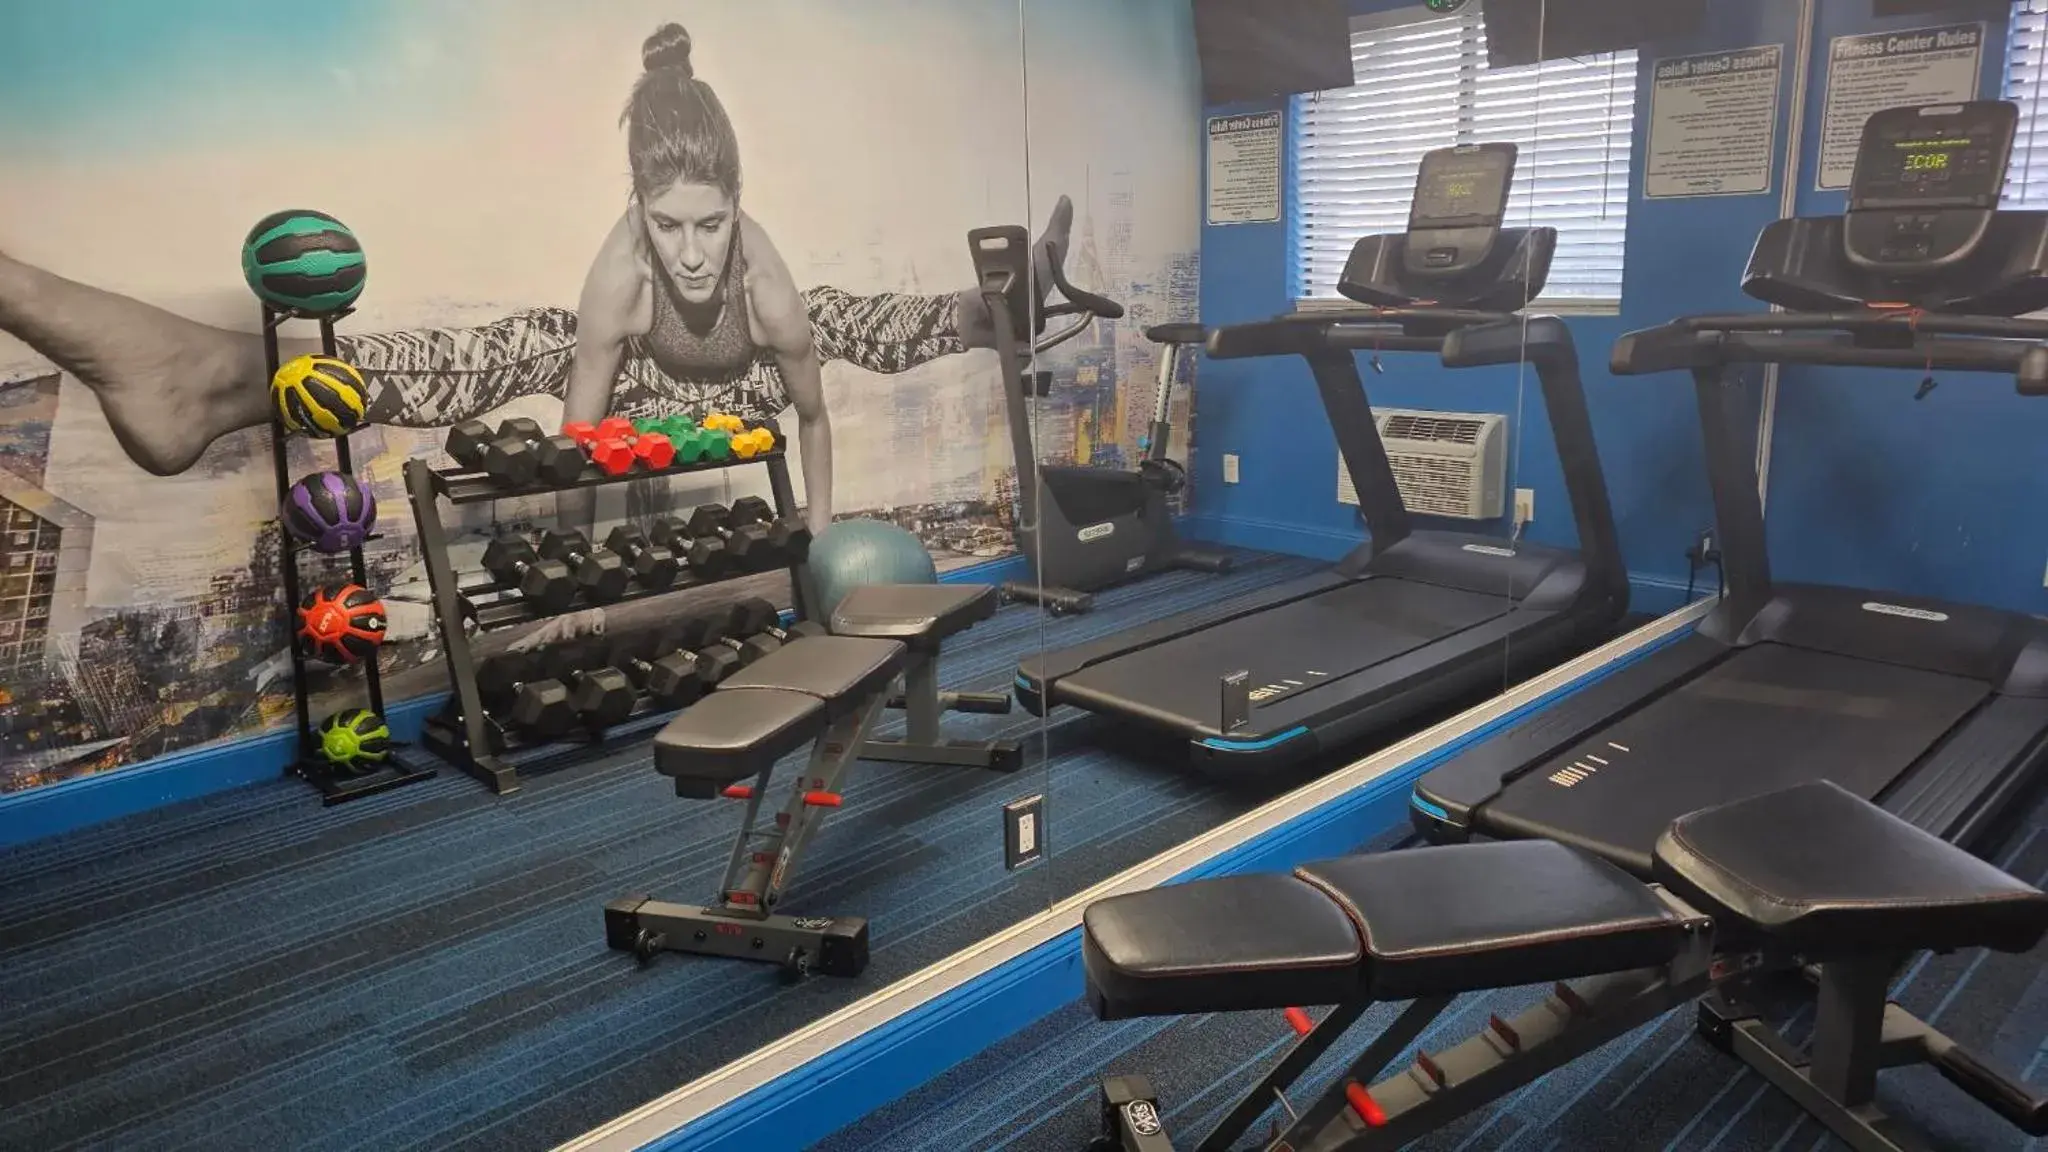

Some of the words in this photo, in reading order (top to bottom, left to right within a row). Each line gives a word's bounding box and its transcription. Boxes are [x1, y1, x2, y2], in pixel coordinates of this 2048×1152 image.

[1836, 41, 1884, 58] Fitness
[1887, 35, 1934, 52] Center
[1937, 30, 1976, 48] Rules
